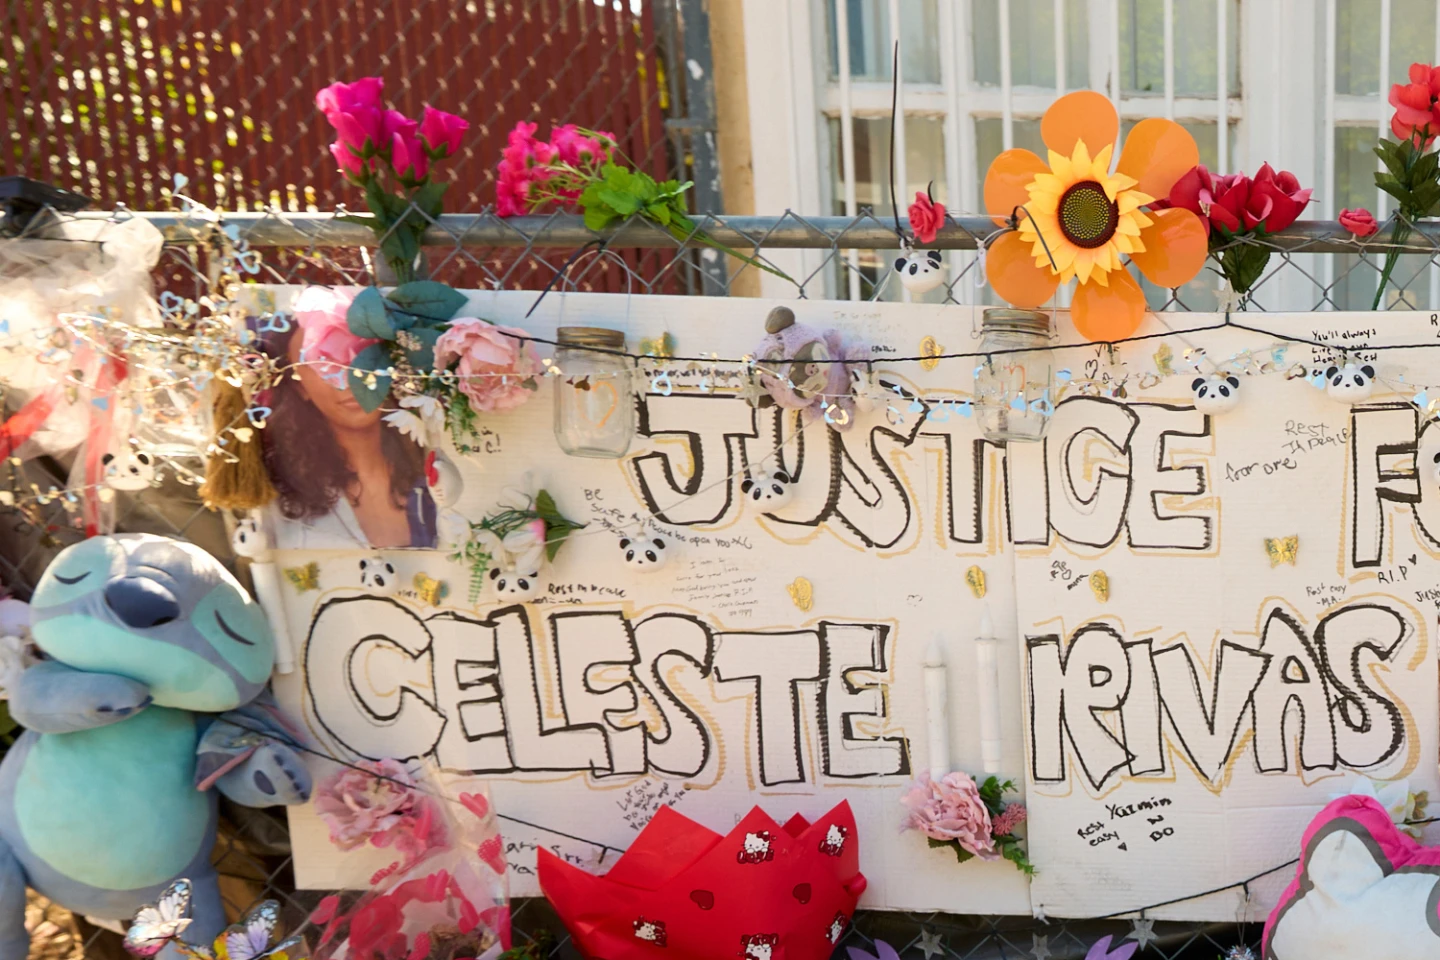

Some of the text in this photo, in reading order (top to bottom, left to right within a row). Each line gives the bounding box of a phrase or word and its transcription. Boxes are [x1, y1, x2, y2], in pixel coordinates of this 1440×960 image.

[632, 372, 1214, 550] JUSTICE
[305, 595, 1416, 790] CELESTE RIVAS
